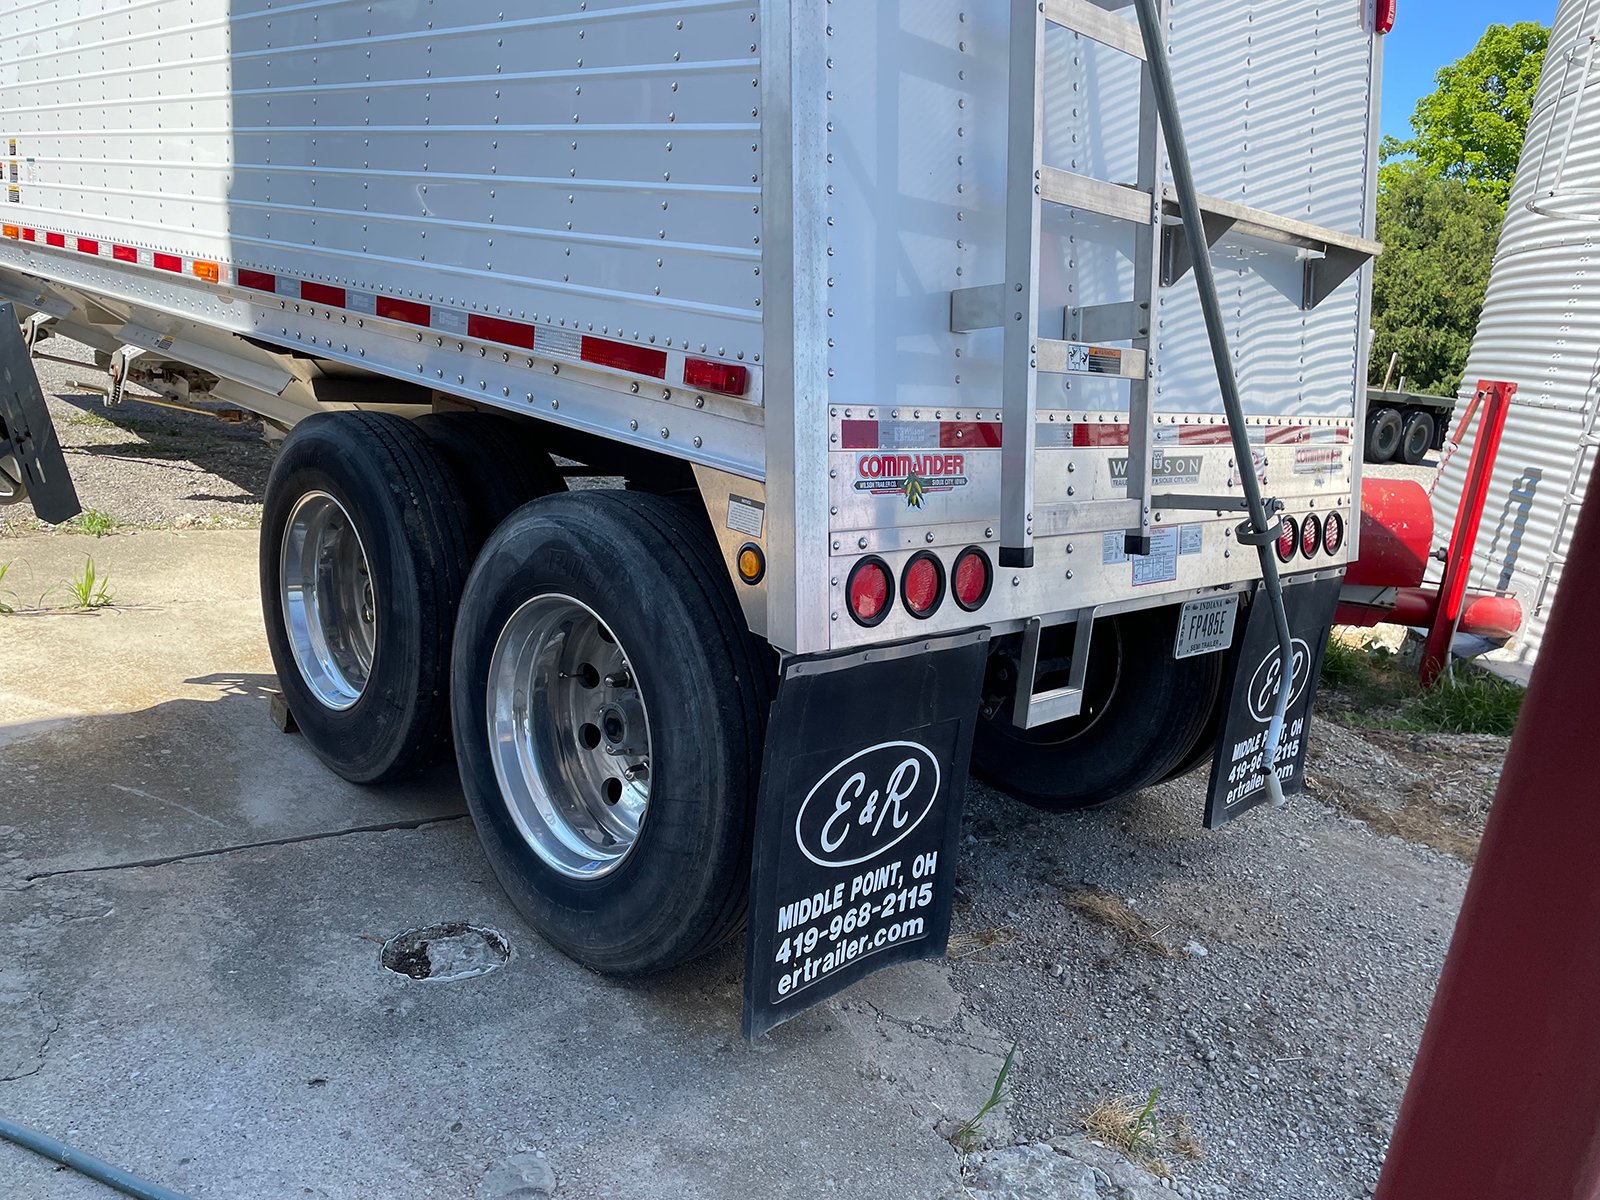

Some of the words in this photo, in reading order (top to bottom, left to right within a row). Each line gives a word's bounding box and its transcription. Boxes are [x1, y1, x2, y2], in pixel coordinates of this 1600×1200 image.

[859, 455, 965, 478] COMMANDER
[1112, 459, 1199, 475] WSON
[859, 481, 875, 489] WILSON
[875, 480, 891, 488] TRAILER
[932, 478, 944, 486] SIOUX
[1199, 600, 1223, 611] INDIANA
[1188, 611, 1227, 640] FP485E
[1190, 643, 1202, 652] SEMI
[1202, 640, 1219, 649] TRAILER
[1231, 728, 1262, 763] MIDDLE
[1290, 717, 1304, 736] OH
[1227, 740, 1299, 783] 419-962115
[777, 882, 845, 933] MIDDLE
[850, 860, 904, 902] POINT,
[912, 851, 938, 880] OH
[775, 882, 933, 965] 419-968-2115
[777, 916, 924, 995] ertrailer.com
